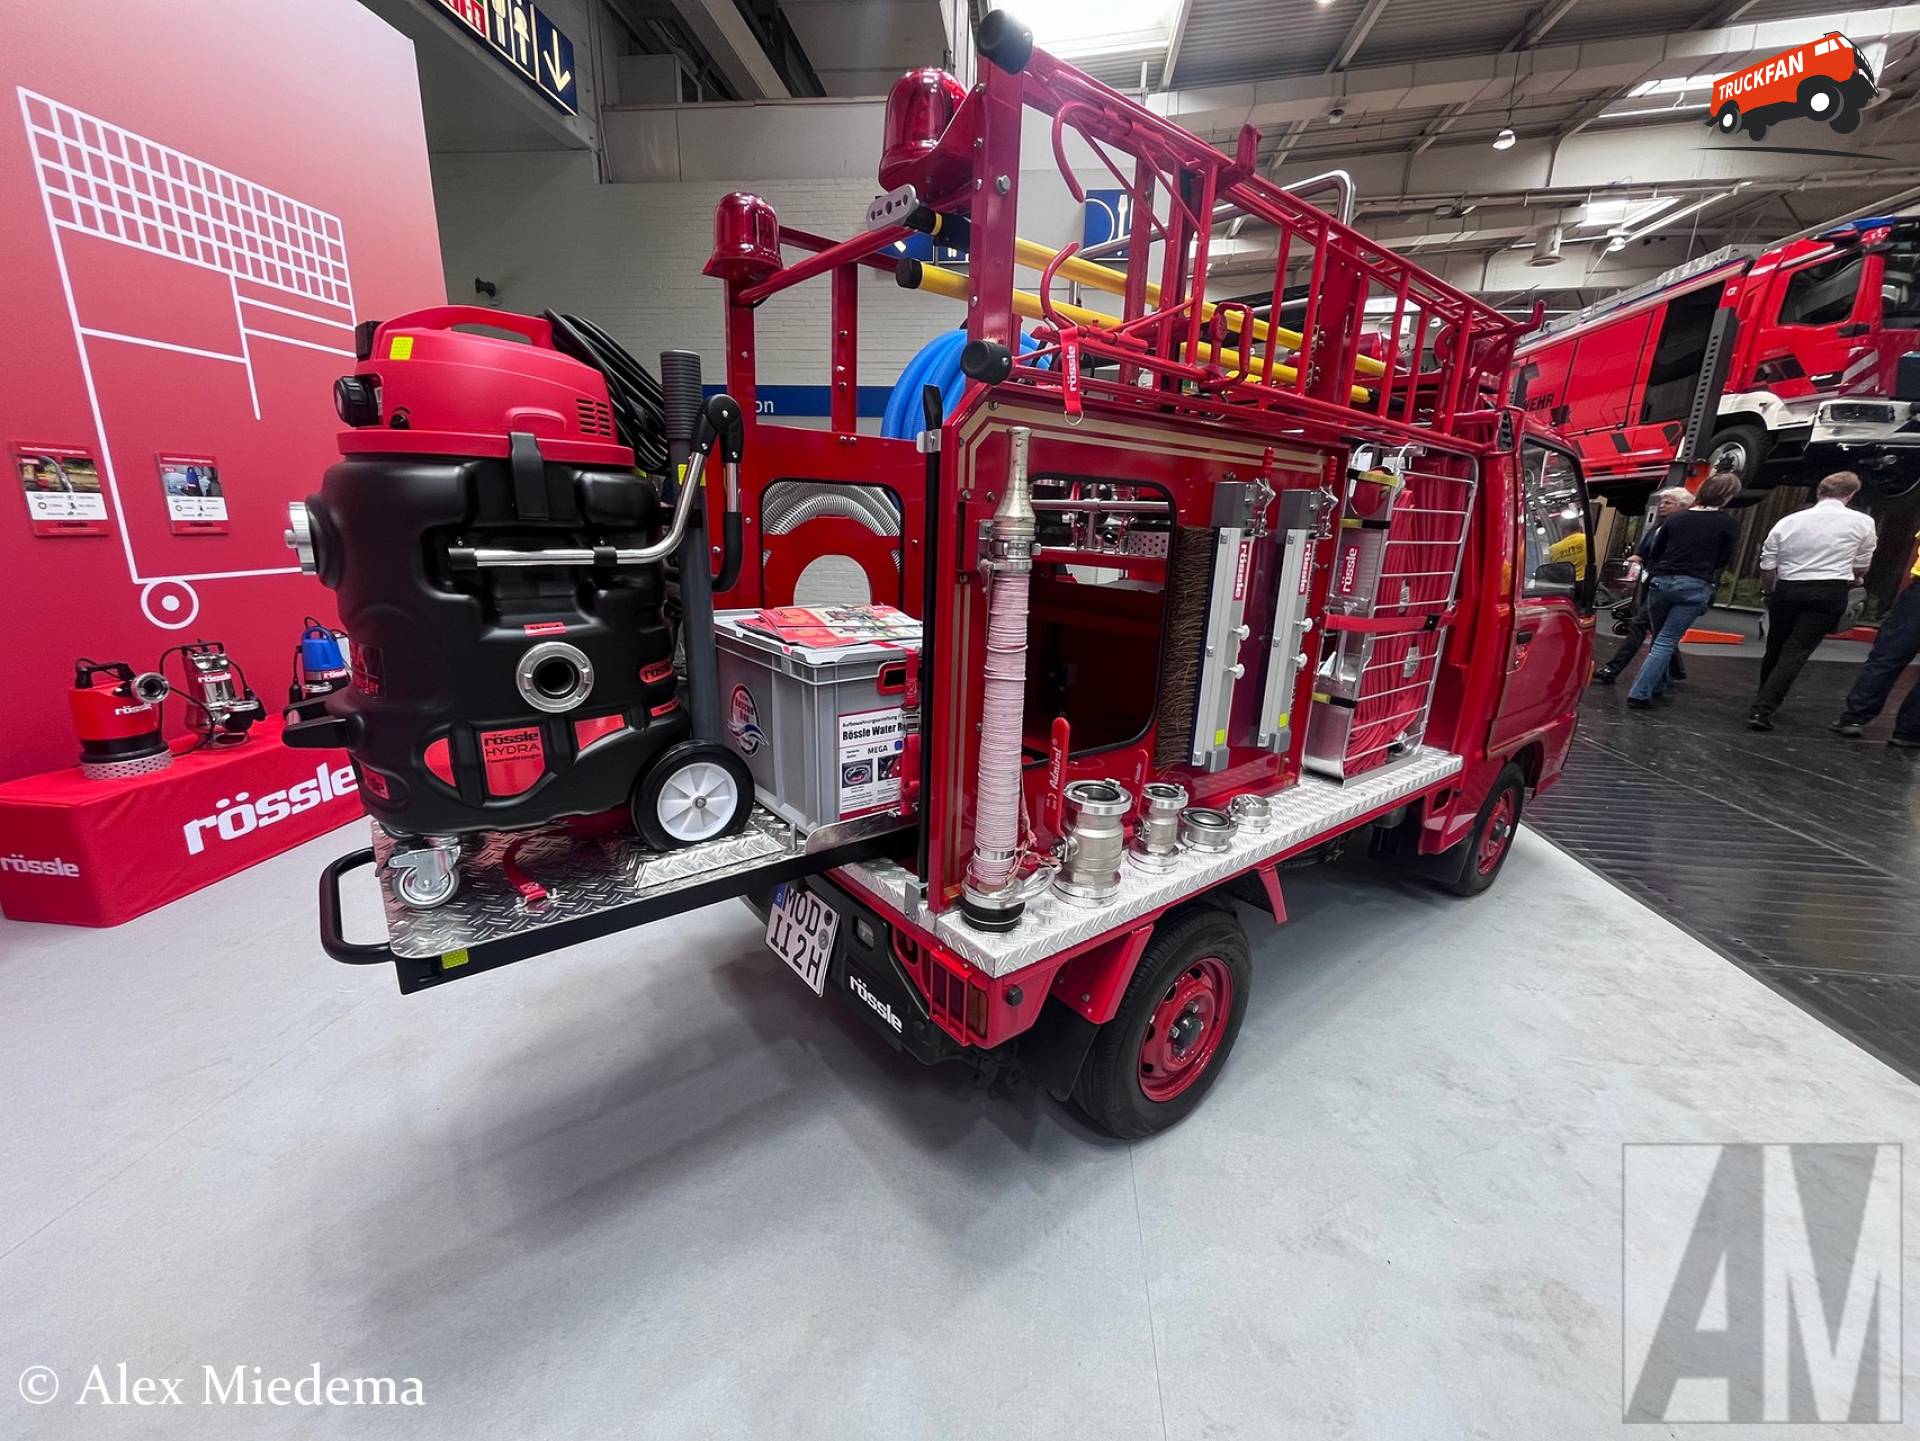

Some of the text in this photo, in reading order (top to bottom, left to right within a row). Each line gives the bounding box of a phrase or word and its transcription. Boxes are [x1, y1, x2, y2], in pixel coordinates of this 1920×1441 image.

[1066, 344, 1077, 392] rössle
[1235, 544, 1248, 598] rössle
[1299, 543, 1312, 593] rössle
[1341, 547, 1358, 592] rössle
[484, 731, 539, 746] rössle
[485, 743, 540, 757] HYDRA
[843, 727, 871, 740] Rössle
[872, 725, 896, 736] Water
[867, 745, 889, 754] MEGA
[183, 762, 359, 855] rössle
[0, 853, 80, 877] rössle
[783, 885, 821, 936] MOD
[849, 975, 903, 1033] rössle
